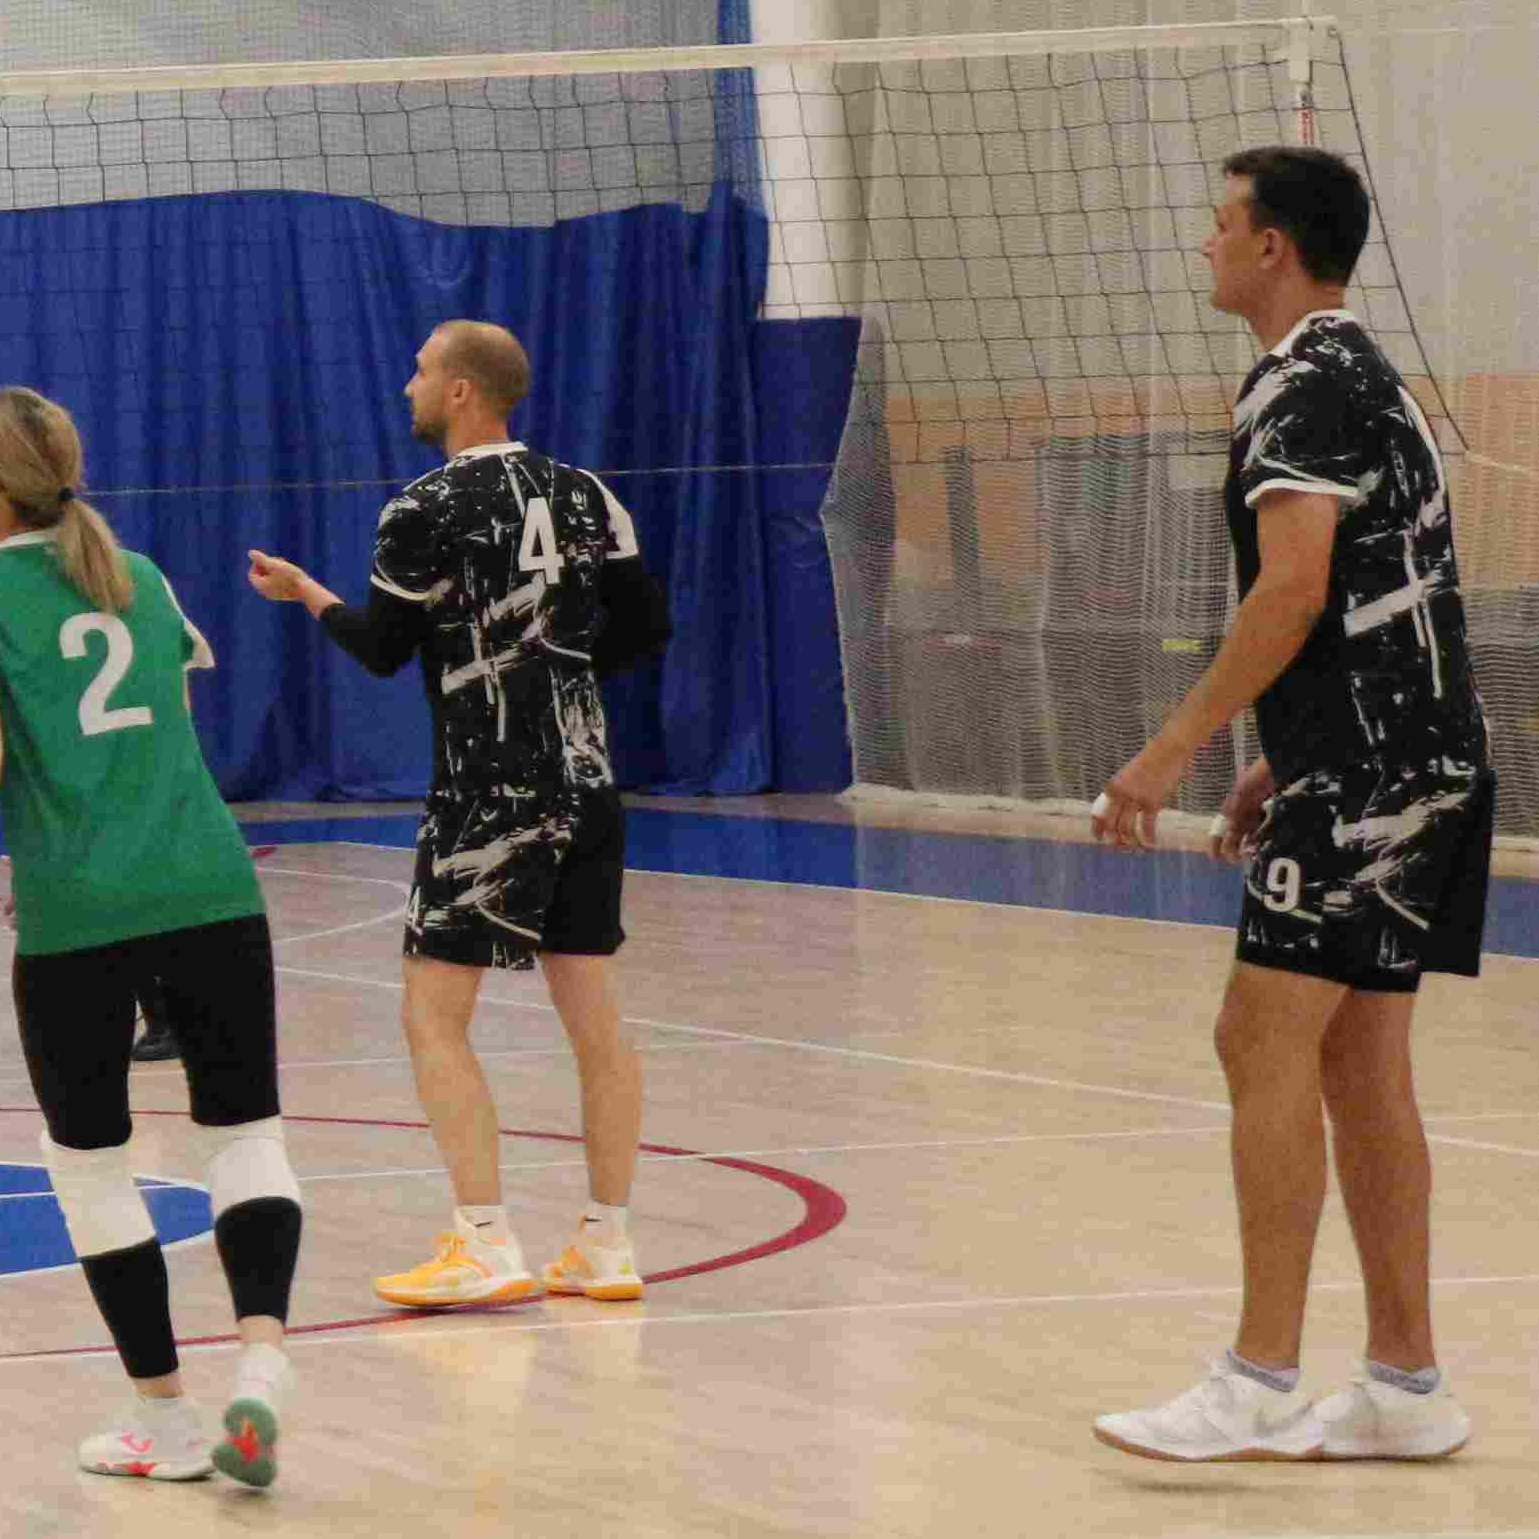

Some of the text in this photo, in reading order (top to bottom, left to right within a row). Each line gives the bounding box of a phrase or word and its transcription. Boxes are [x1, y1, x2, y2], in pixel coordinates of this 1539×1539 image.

[518, 497, 565, 584] 4
[59, 612, 154, 735] 2
[1264, 857, 1301, 912] 9
